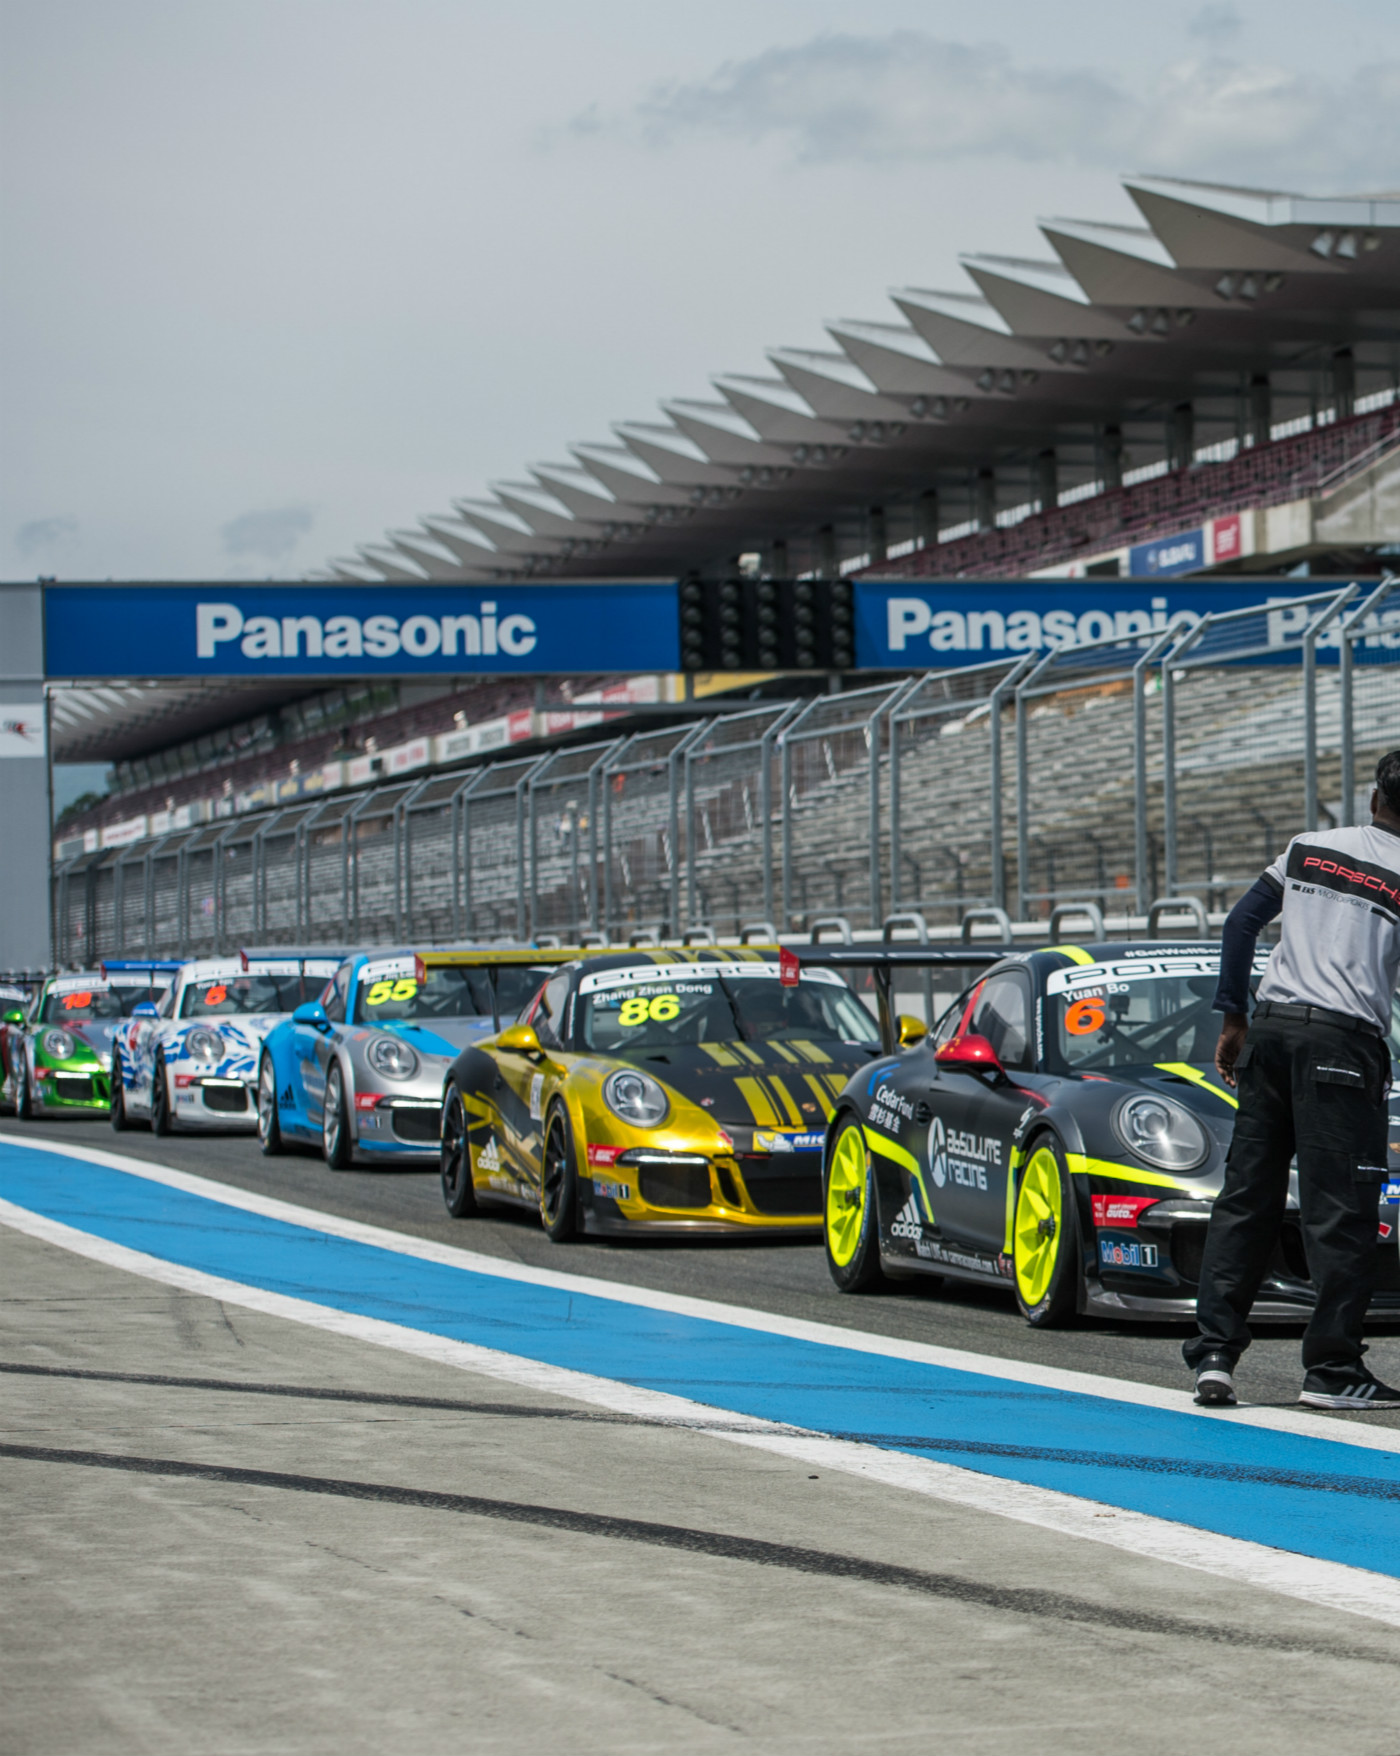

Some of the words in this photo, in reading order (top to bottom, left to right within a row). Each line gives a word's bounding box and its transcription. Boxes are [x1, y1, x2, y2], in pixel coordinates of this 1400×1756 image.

[197, 602, 536, 658] Panasonic
[366, 978, 418, 1006] 55
[675, 984, 712, 996] Dong
[1061, 986, 1103, 1002] Yuan
[1106, 983, 1130, 995] Bo
[618, 994, 680, 1027] 86
[1064, 997, 1106, 1036] 6
[890, 1221, 923, 1241] adidas
[1101, 1241, 1140, 1266] Mobil
